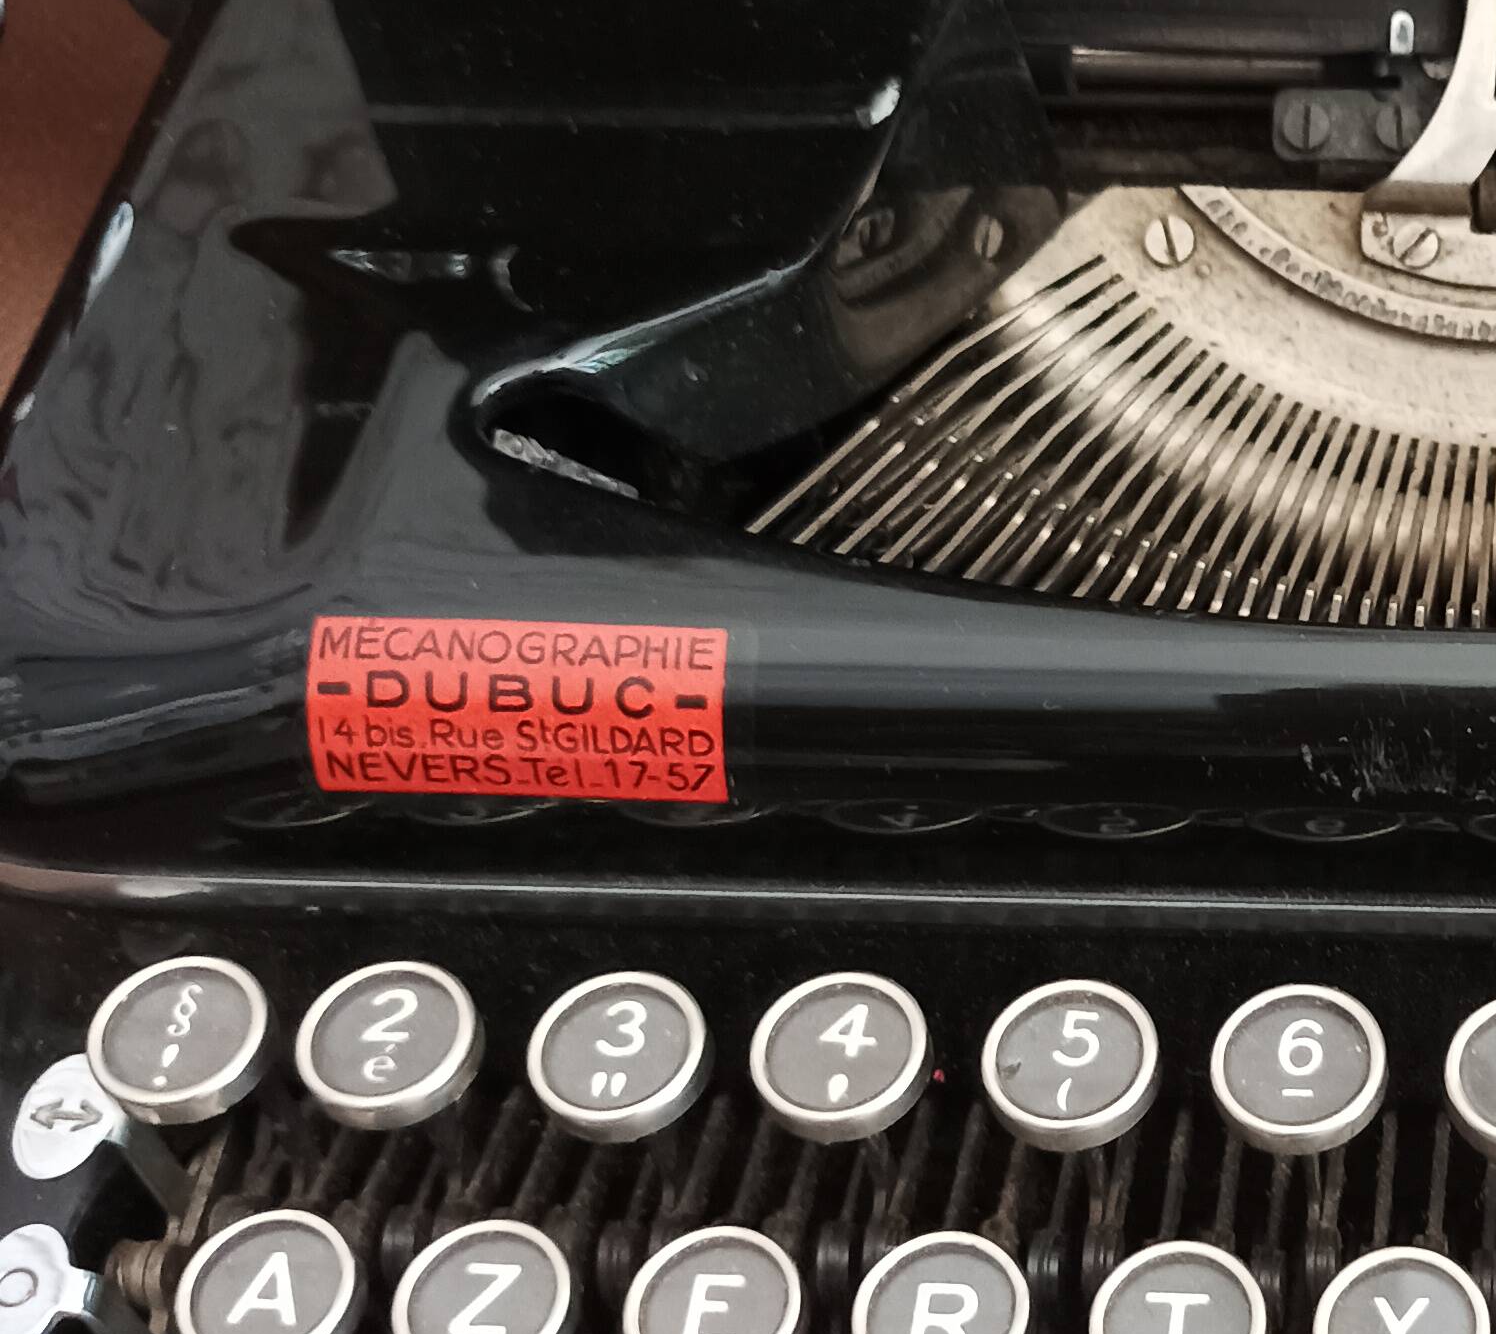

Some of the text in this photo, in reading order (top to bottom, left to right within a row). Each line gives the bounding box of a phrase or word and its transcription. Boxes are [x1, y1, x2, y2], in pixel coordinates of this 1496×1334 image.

[429, 718, 505, 750] Rue
[360, 988, 419, 1043] 2
[595, 1000, 648, 1058] 3
[818, 1003, 878, 1058] 4
[1051, 1009, 1100, 1068] 5
[151, 1043, 183, 1088] !
[362, 1043, 396, 1083] é
[1277, 1018, 1324, 1077] 6
[226, 1251, 297, 1327] A
